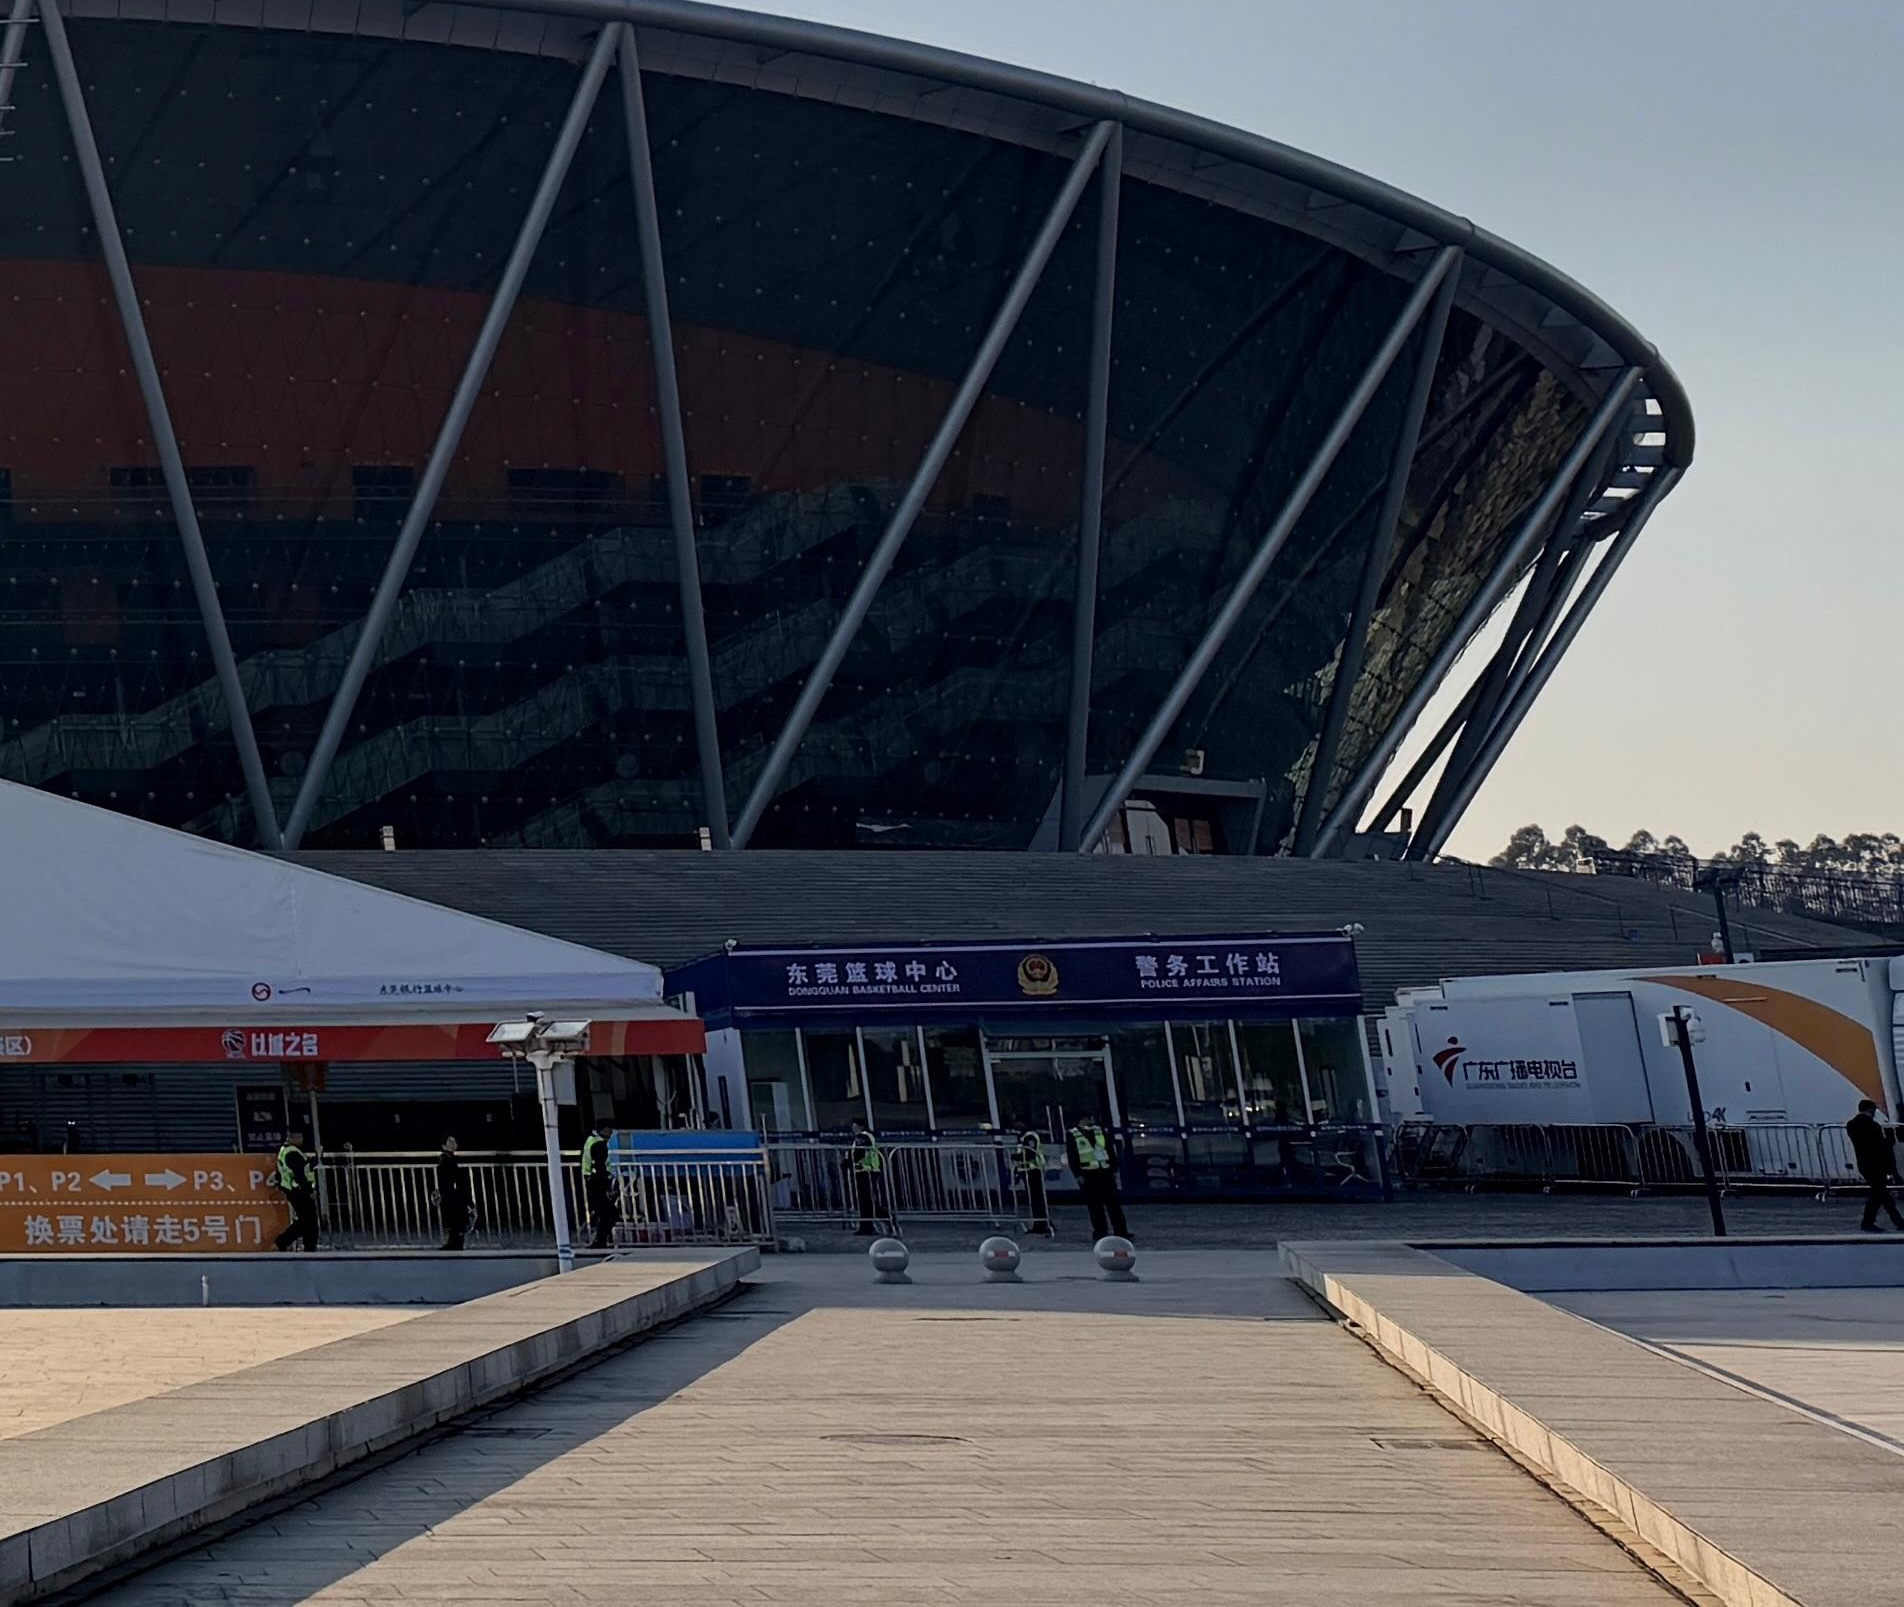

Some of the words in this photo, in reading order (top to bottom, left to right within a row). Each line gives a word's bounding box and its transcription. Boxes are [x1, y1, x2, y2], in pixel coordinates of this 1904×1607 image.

[786, 959, 958, 985] 东莞篮球中心
[1134, 951, 1280, 977] 警务工作站
[788, 985, 849, 996] DONGGUAN
[852, 984, 917, 994] BASKETBALL
[920, 983, 960, 993] CENTER
[1140, 978, 1178, 989] POLICE
[1183, 977, 1228, 987] AFFAIRS
[1232, 976, 1281, 986] STATION
[1462, 1059, 1578, 1081] 广东广播电视台
[24, 1214, 262, 1246] 换票处请走5号门
